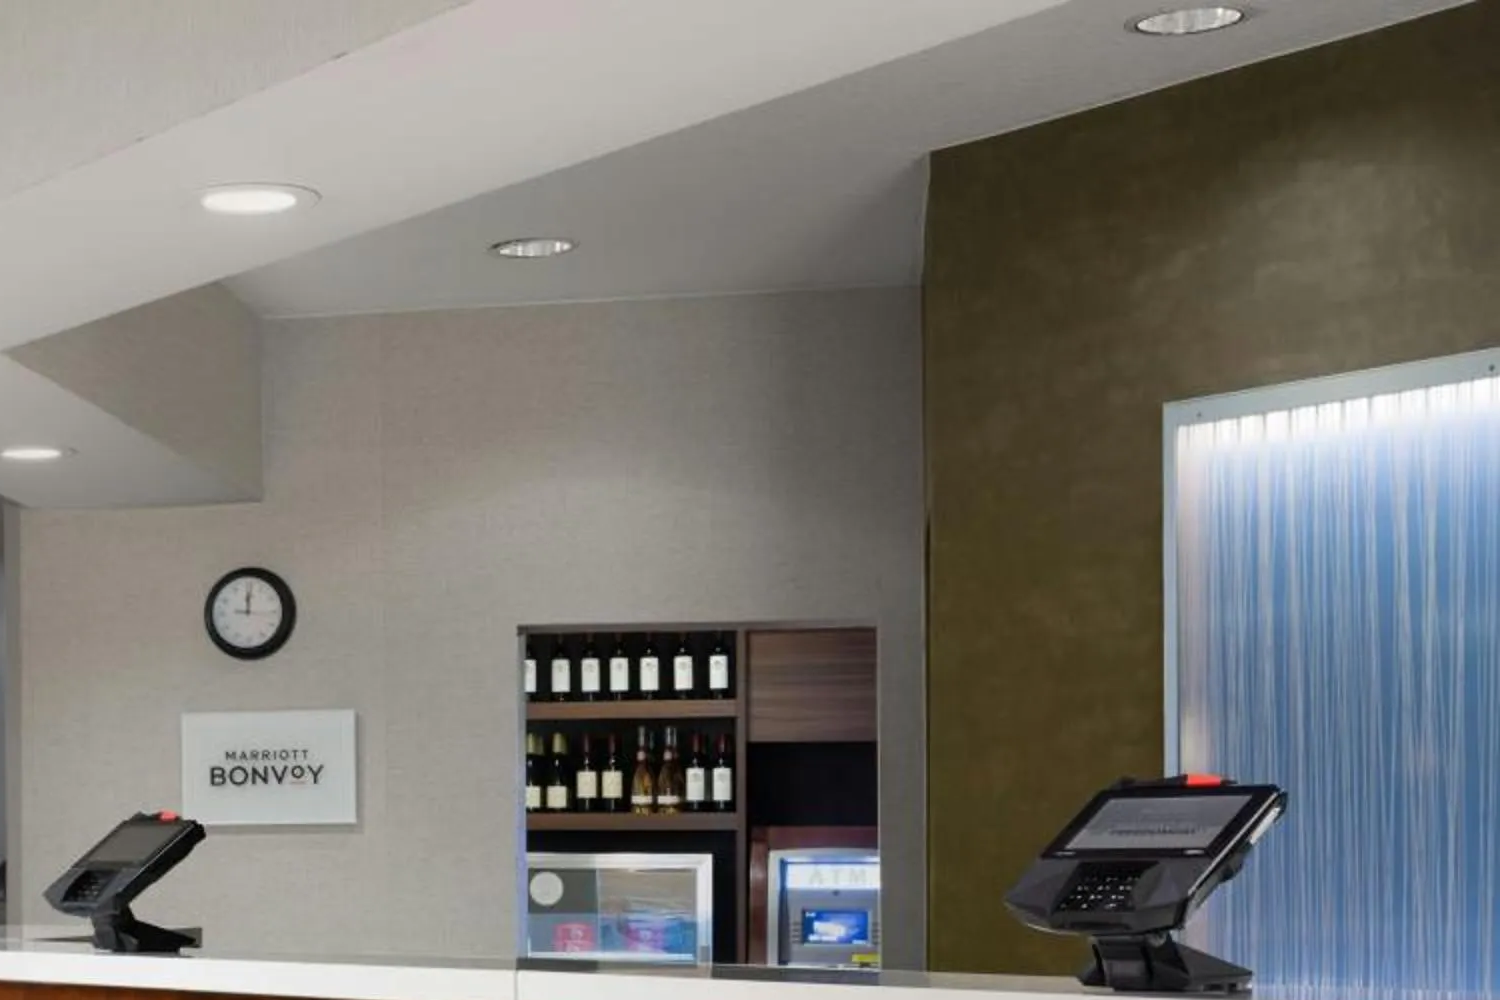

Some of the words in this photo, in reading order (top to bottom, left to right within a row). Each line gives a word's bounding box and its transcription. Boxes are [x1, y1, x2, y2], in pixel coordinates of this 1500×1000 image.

[225, 749, 309, 761] MARRIOTT
[209, 764, 325, 787] BONVOY
[808, 868, 867, 886] ATM
